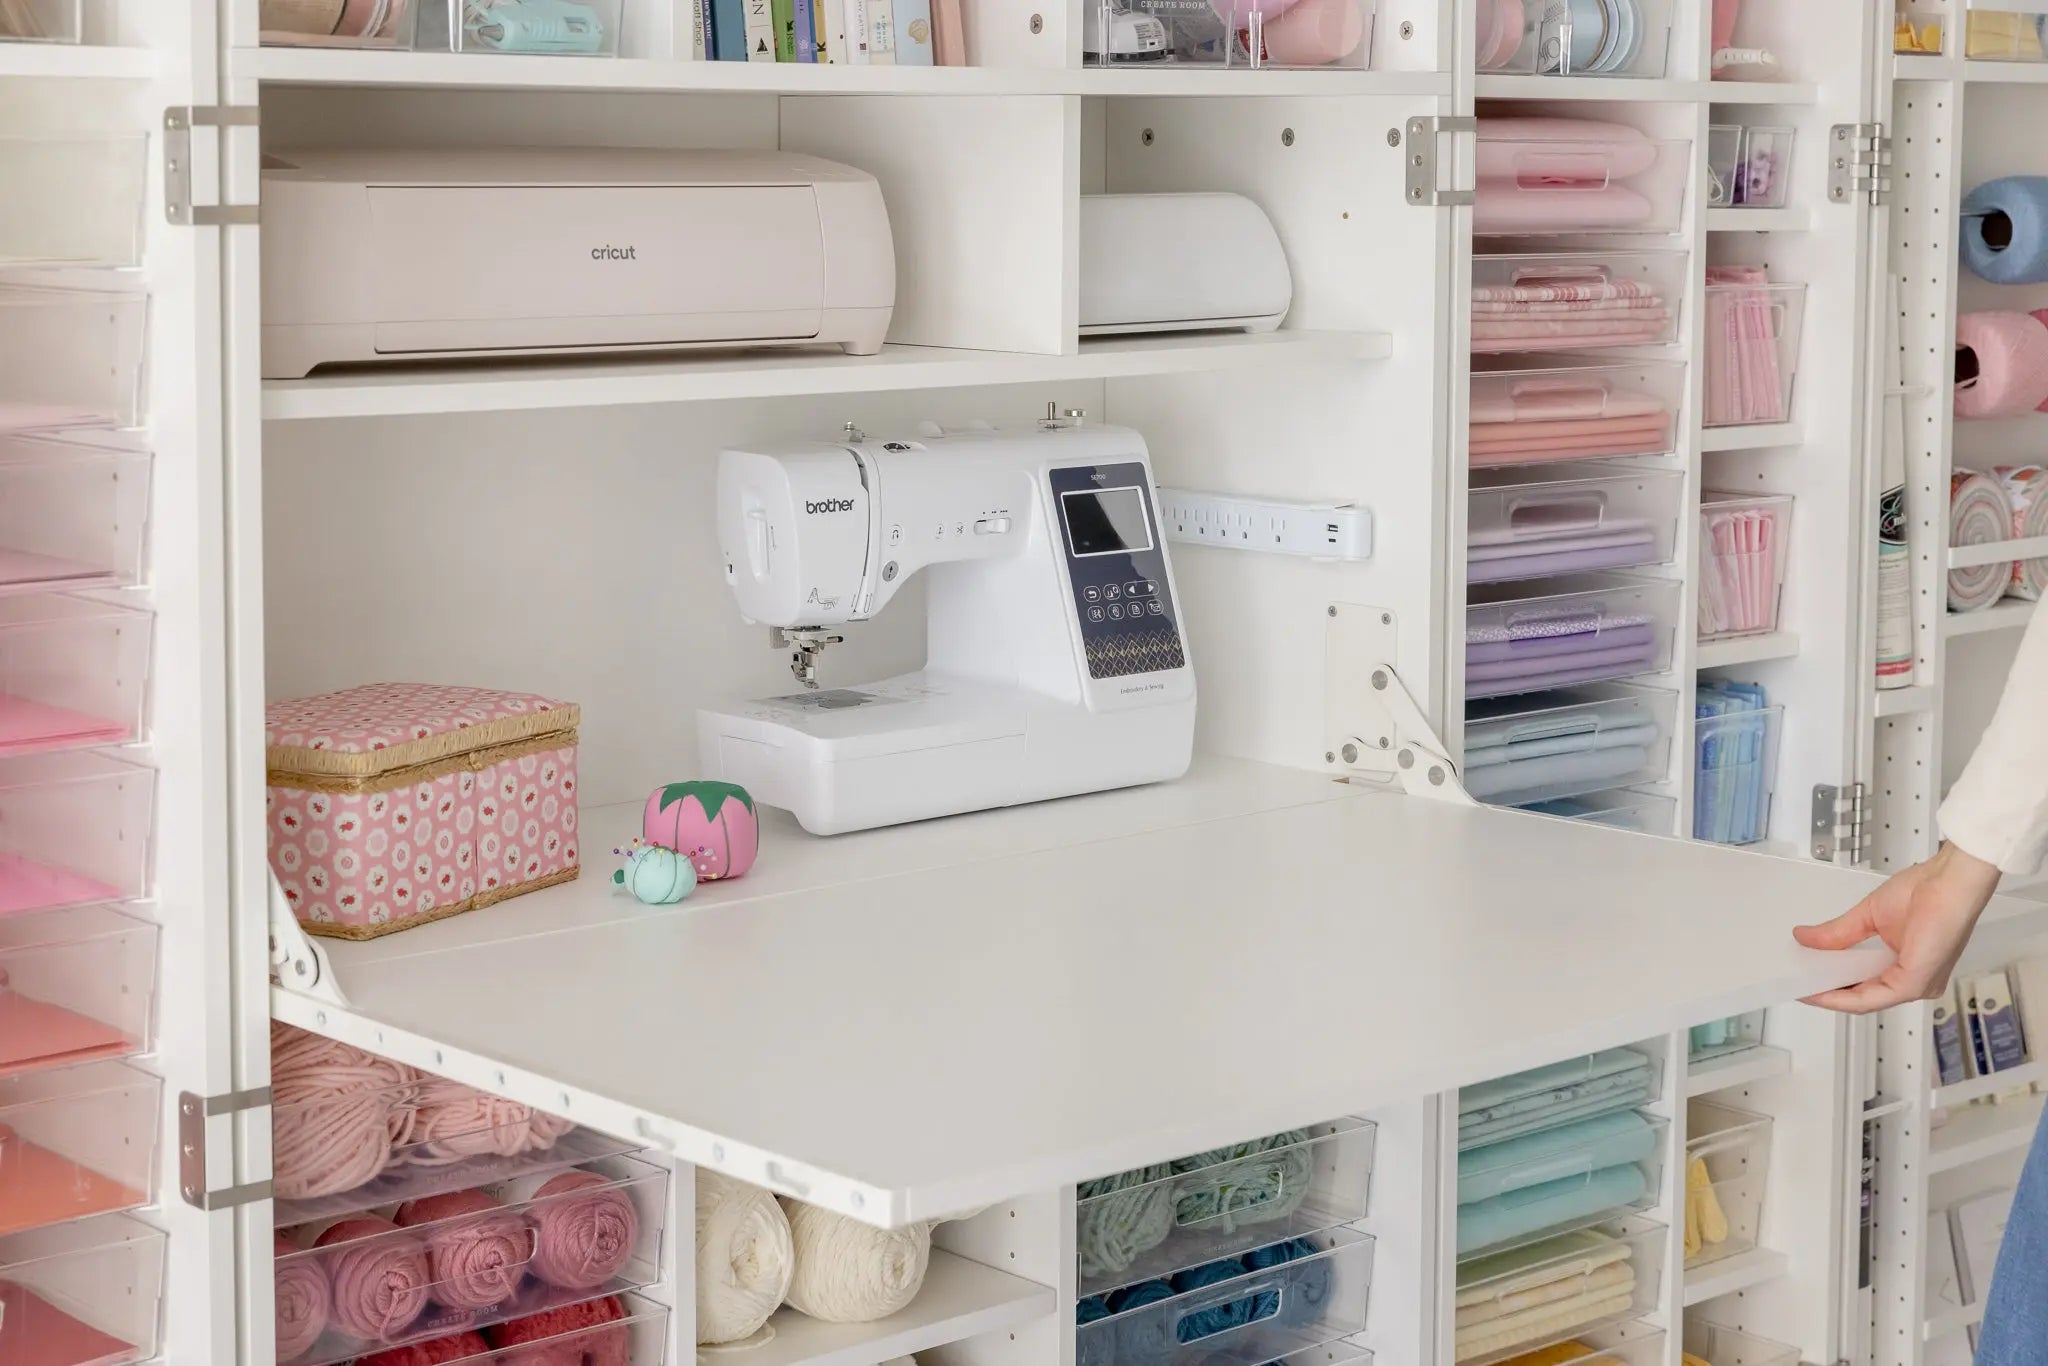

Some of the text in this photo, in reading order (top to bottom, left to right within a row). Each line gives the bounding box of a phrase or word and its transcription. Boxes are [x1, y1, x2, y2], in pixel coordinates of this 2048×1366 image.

[1140, 0, 1206, 10] CREATE ROOM
[695, 22, 703, 46] Shop
[591, 244, 636, 260] cricut
[805, 497, 855, 515] brother
